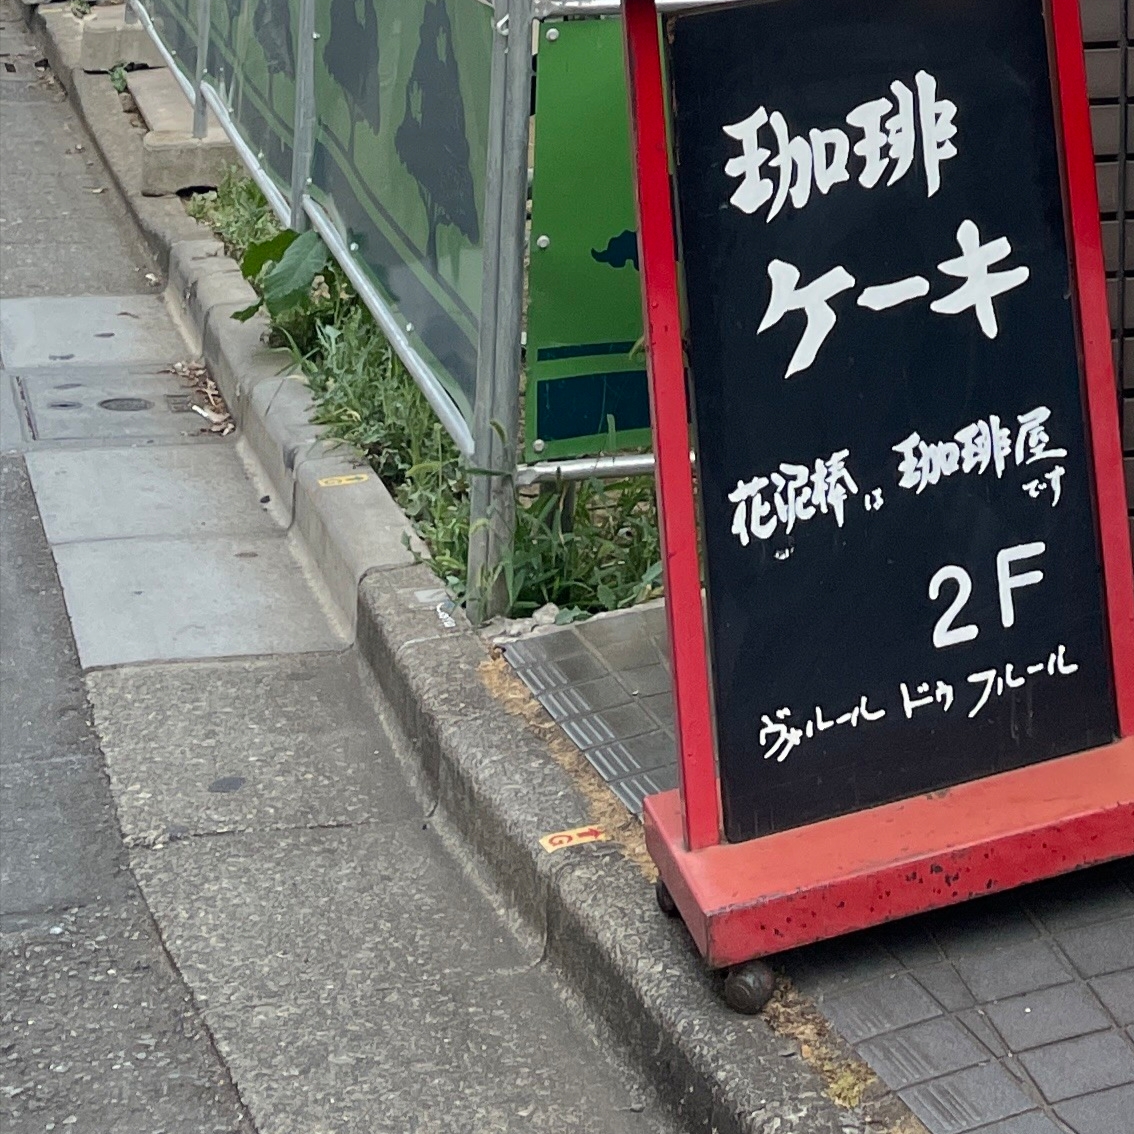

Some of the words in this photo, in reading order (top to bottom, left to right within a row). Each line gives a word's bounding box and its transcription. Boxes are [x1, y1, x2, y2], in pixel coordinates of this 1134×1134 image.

[722, 69, 959, 224] 珈琲
[756, 219, 1030, 379] ケーキ
[928, 541, 1046, 648] 2F
[967, 644, 1079, 718] フルール
